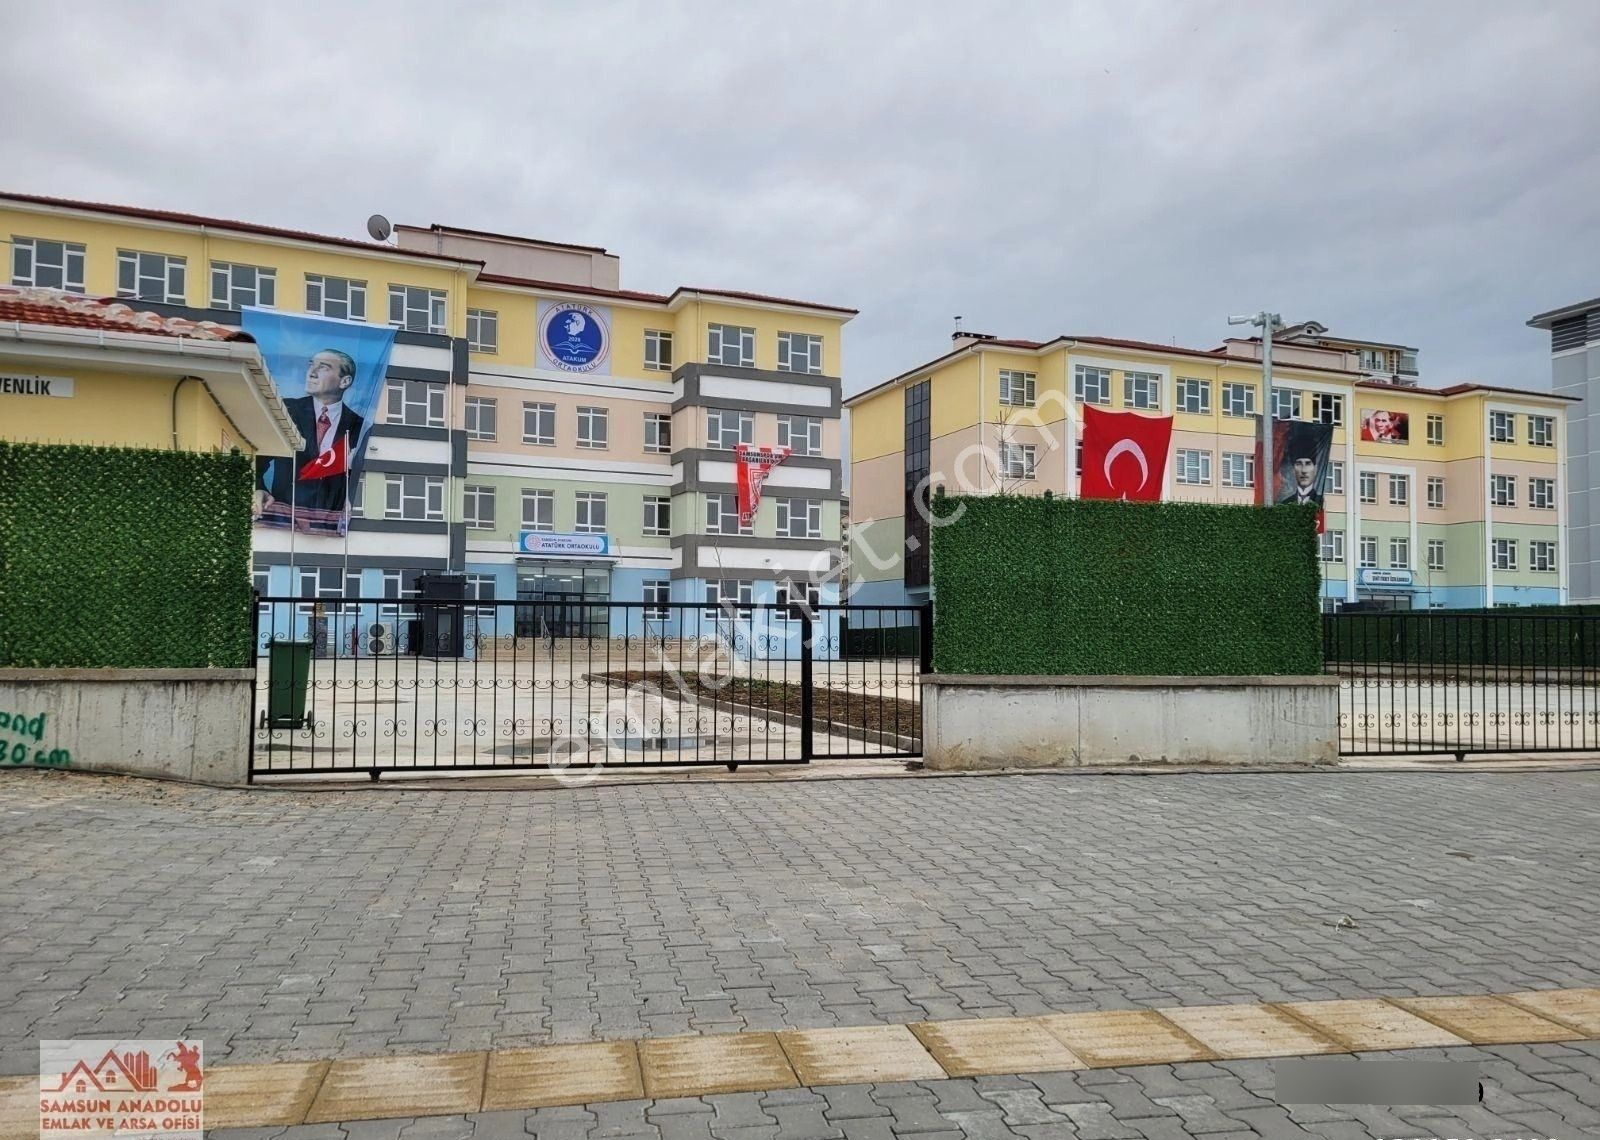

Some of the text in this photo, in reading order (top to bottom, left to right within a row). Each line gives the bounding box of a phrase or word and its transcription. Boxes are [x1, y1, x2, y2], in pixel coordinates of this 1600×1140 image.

[562, 355, 587, 363] ATAKUM
[553, 358, 596, 374] ORTAOKULU
[541, 541, 600, 551] ATATÜRK ORTAOKULU
[34, 749, 71, 767] cm
